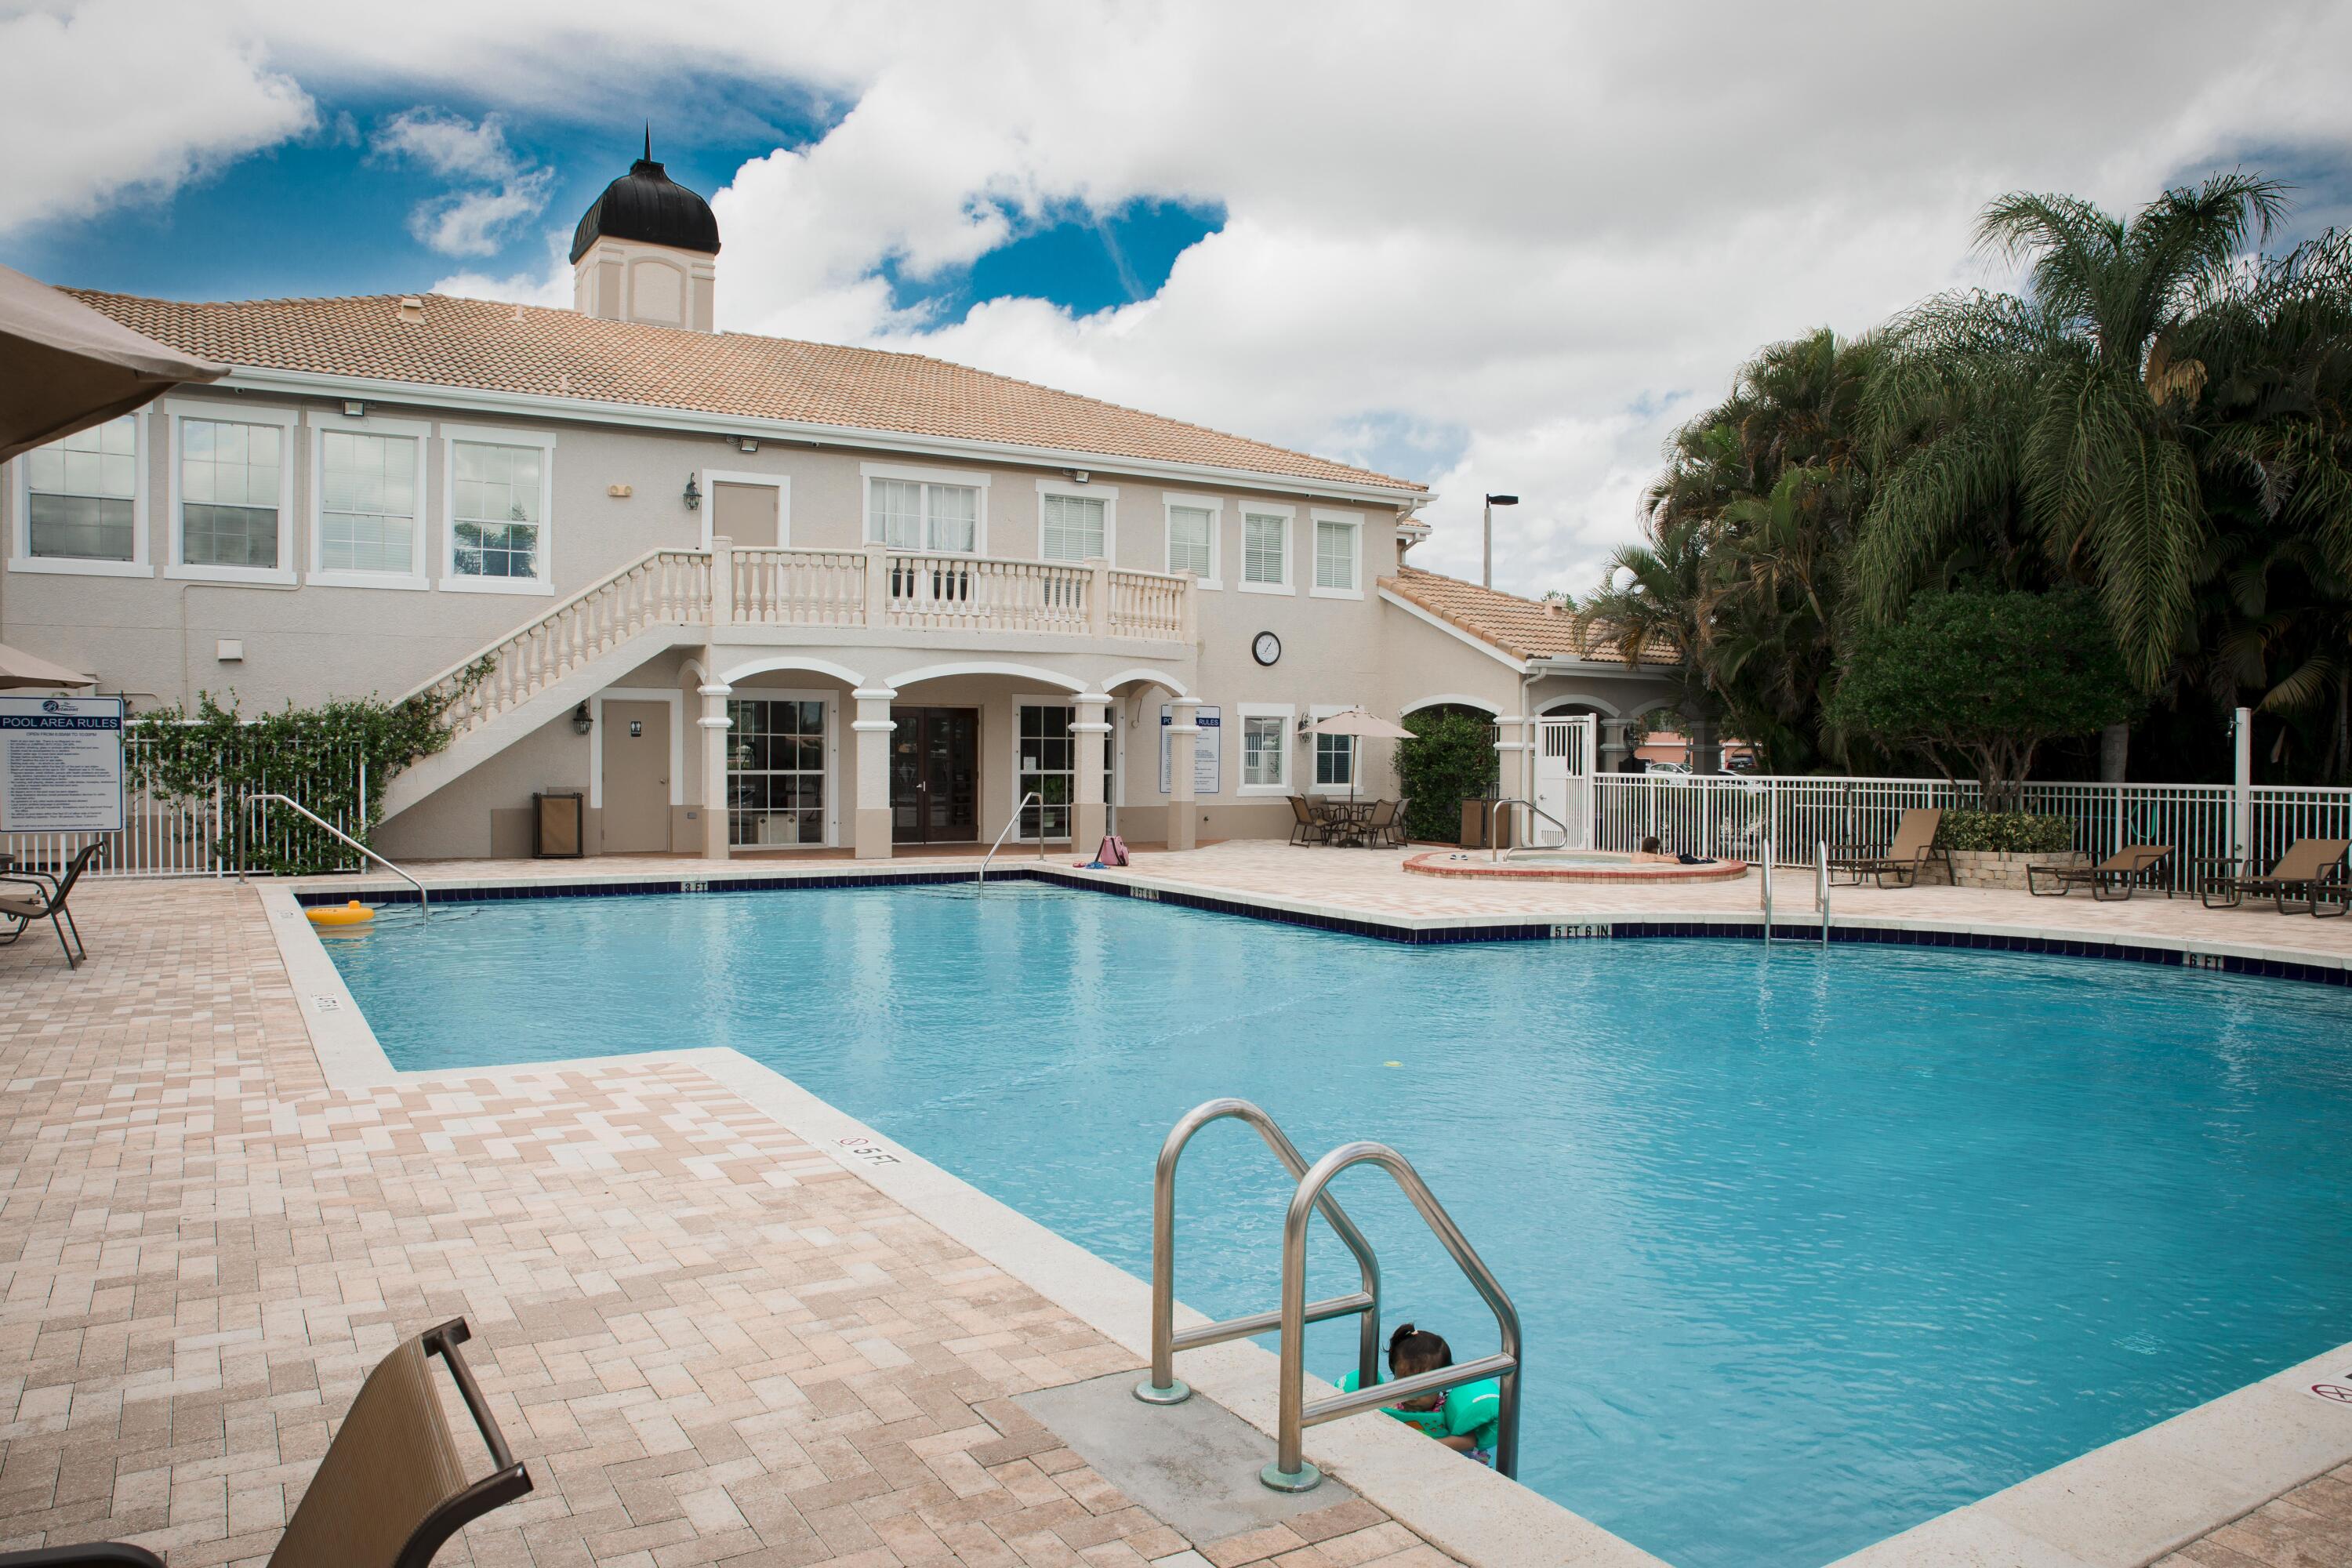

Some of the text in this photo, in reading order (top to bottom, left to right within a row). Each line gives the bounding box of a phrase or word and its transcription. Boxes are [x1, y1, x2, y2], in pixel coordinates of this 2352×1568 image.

[2, 717, 118, 728] POOL AREA RULES
[685, 882, 706, 891] 3 FT
[1138, 887, 1144, 898] FT
[1152, 890, 1157, 900] IN
[1555, 925, 1609, 938] 5 FT 6 IN
[2204, 955, 2221, 970] FT
[863, 1154, 902, 1166] FT
